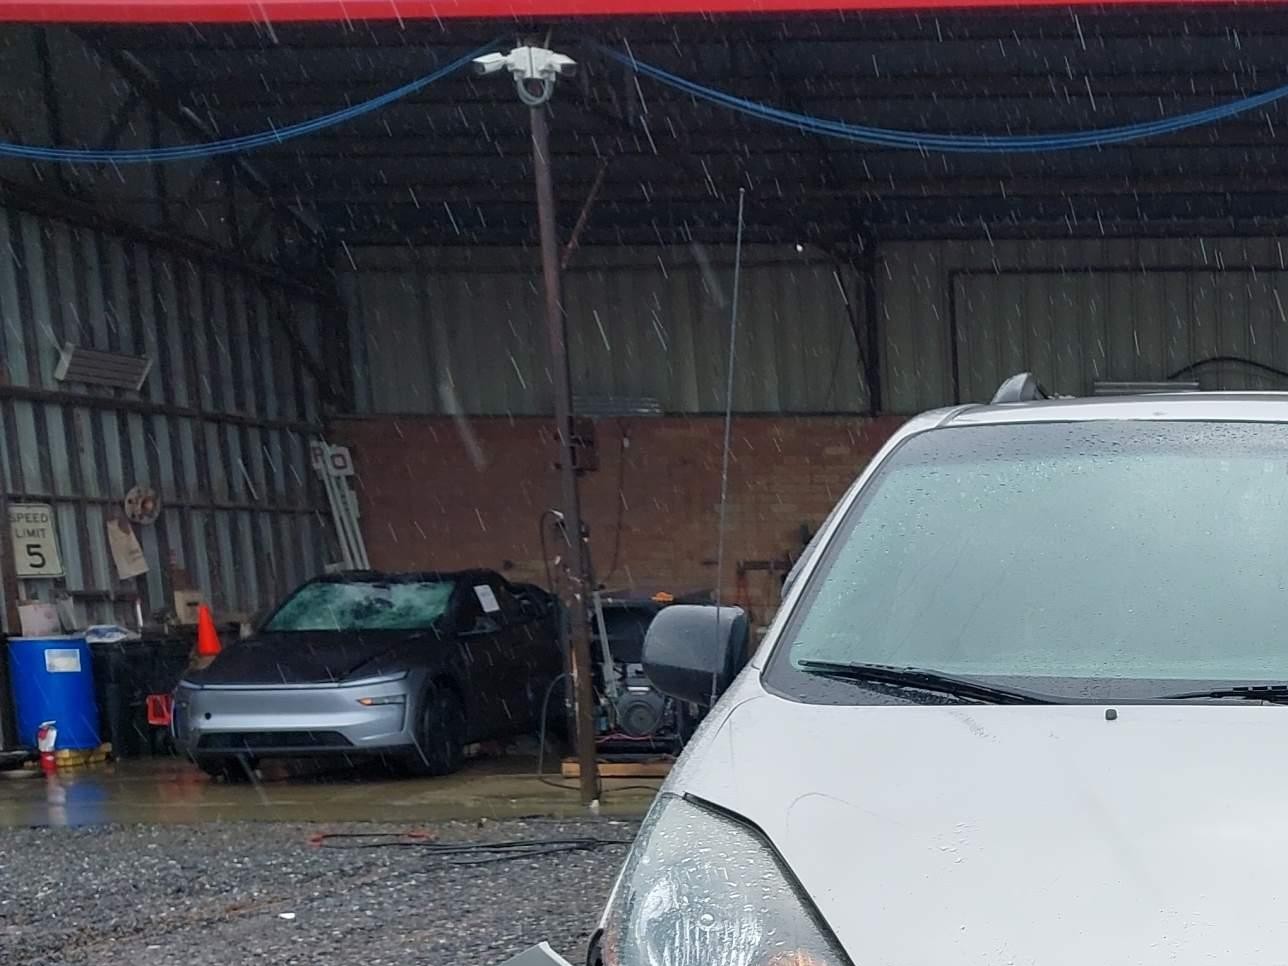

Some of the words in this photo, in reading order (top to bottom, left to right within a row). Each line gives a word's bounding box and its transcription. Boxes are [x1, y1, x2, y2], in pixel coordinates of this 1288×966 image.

[9, 512, 49, 523] SPEED
[16, 528, 47, 538] LIMIT
[26, 544, 46, 568] 5
